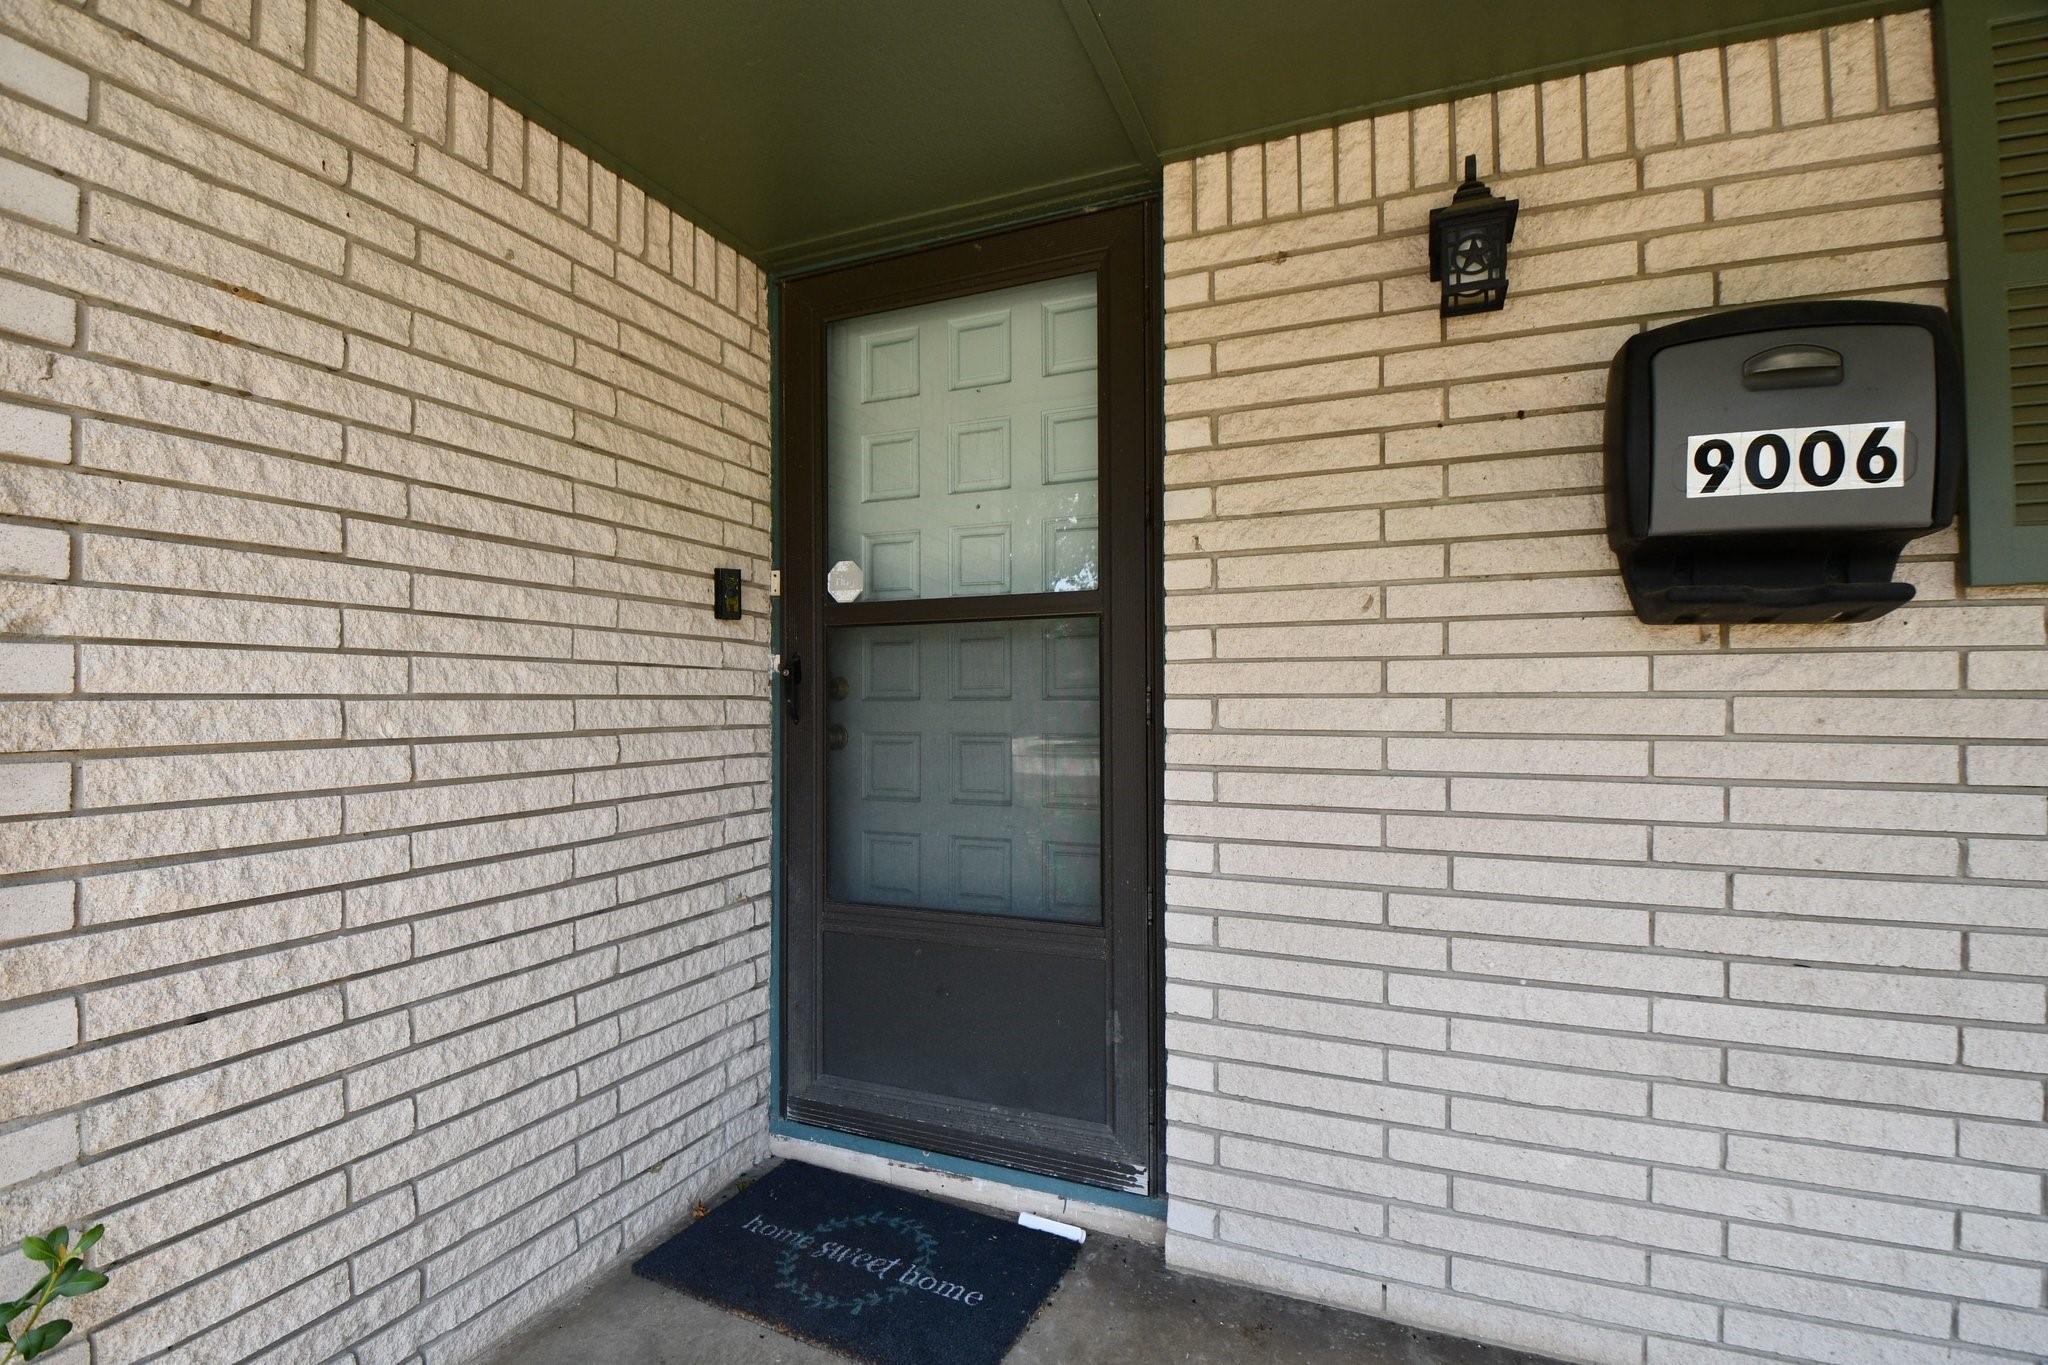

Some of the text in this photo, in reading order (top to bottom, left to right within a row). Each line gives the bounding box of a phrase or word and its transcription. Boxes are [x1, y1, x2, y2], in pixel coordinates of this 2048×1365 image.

[1693, 426, 1898, 494] 9006
[742, 1214, 984, 1306] home sweet home
